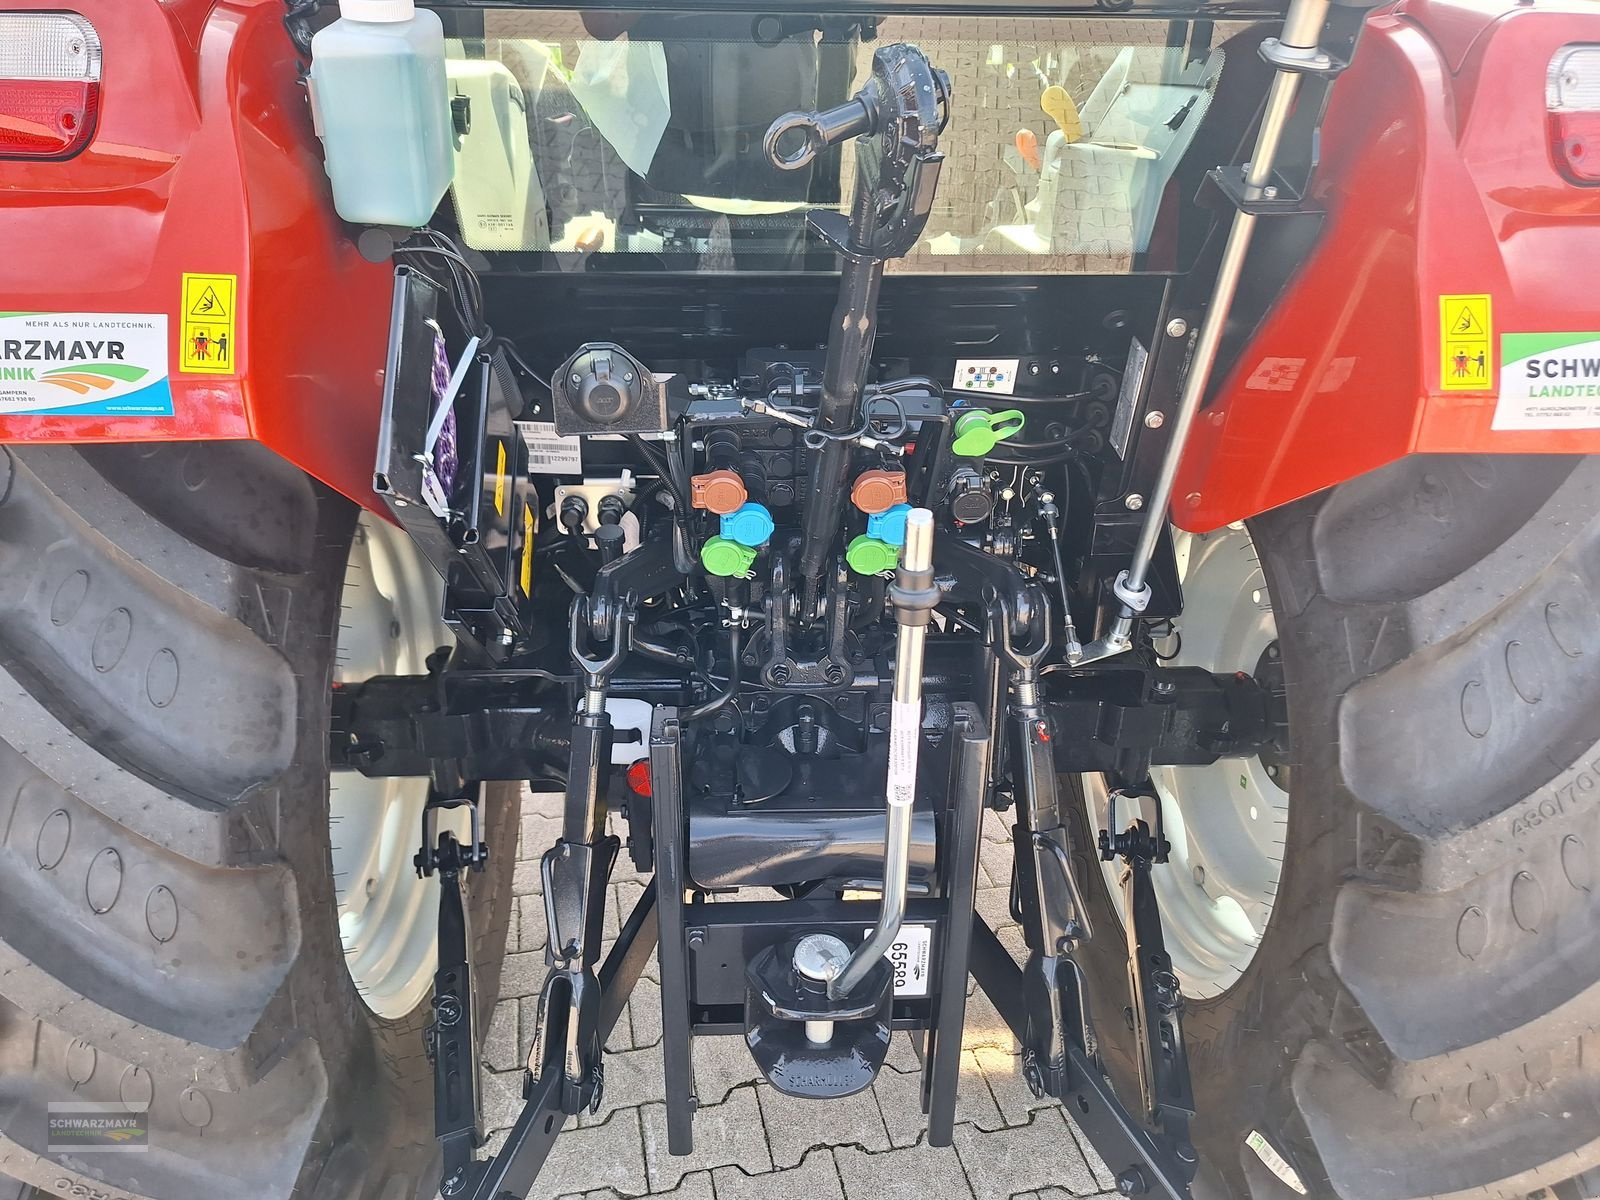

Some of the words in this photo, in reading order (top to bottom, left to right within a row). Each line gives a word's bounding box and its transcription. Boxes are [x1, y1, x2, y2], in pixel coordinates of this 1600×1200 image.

[25, 320, 50, 328] MEHR
[52, 320, 69, 328] ALS
[93, 321, 156, 329] LANDTECHNIK.
[0, 340, 125, 361] RZMAYR
[551, 455, 579, 463] 12299797
[891, 942, 909, 988] 65589
